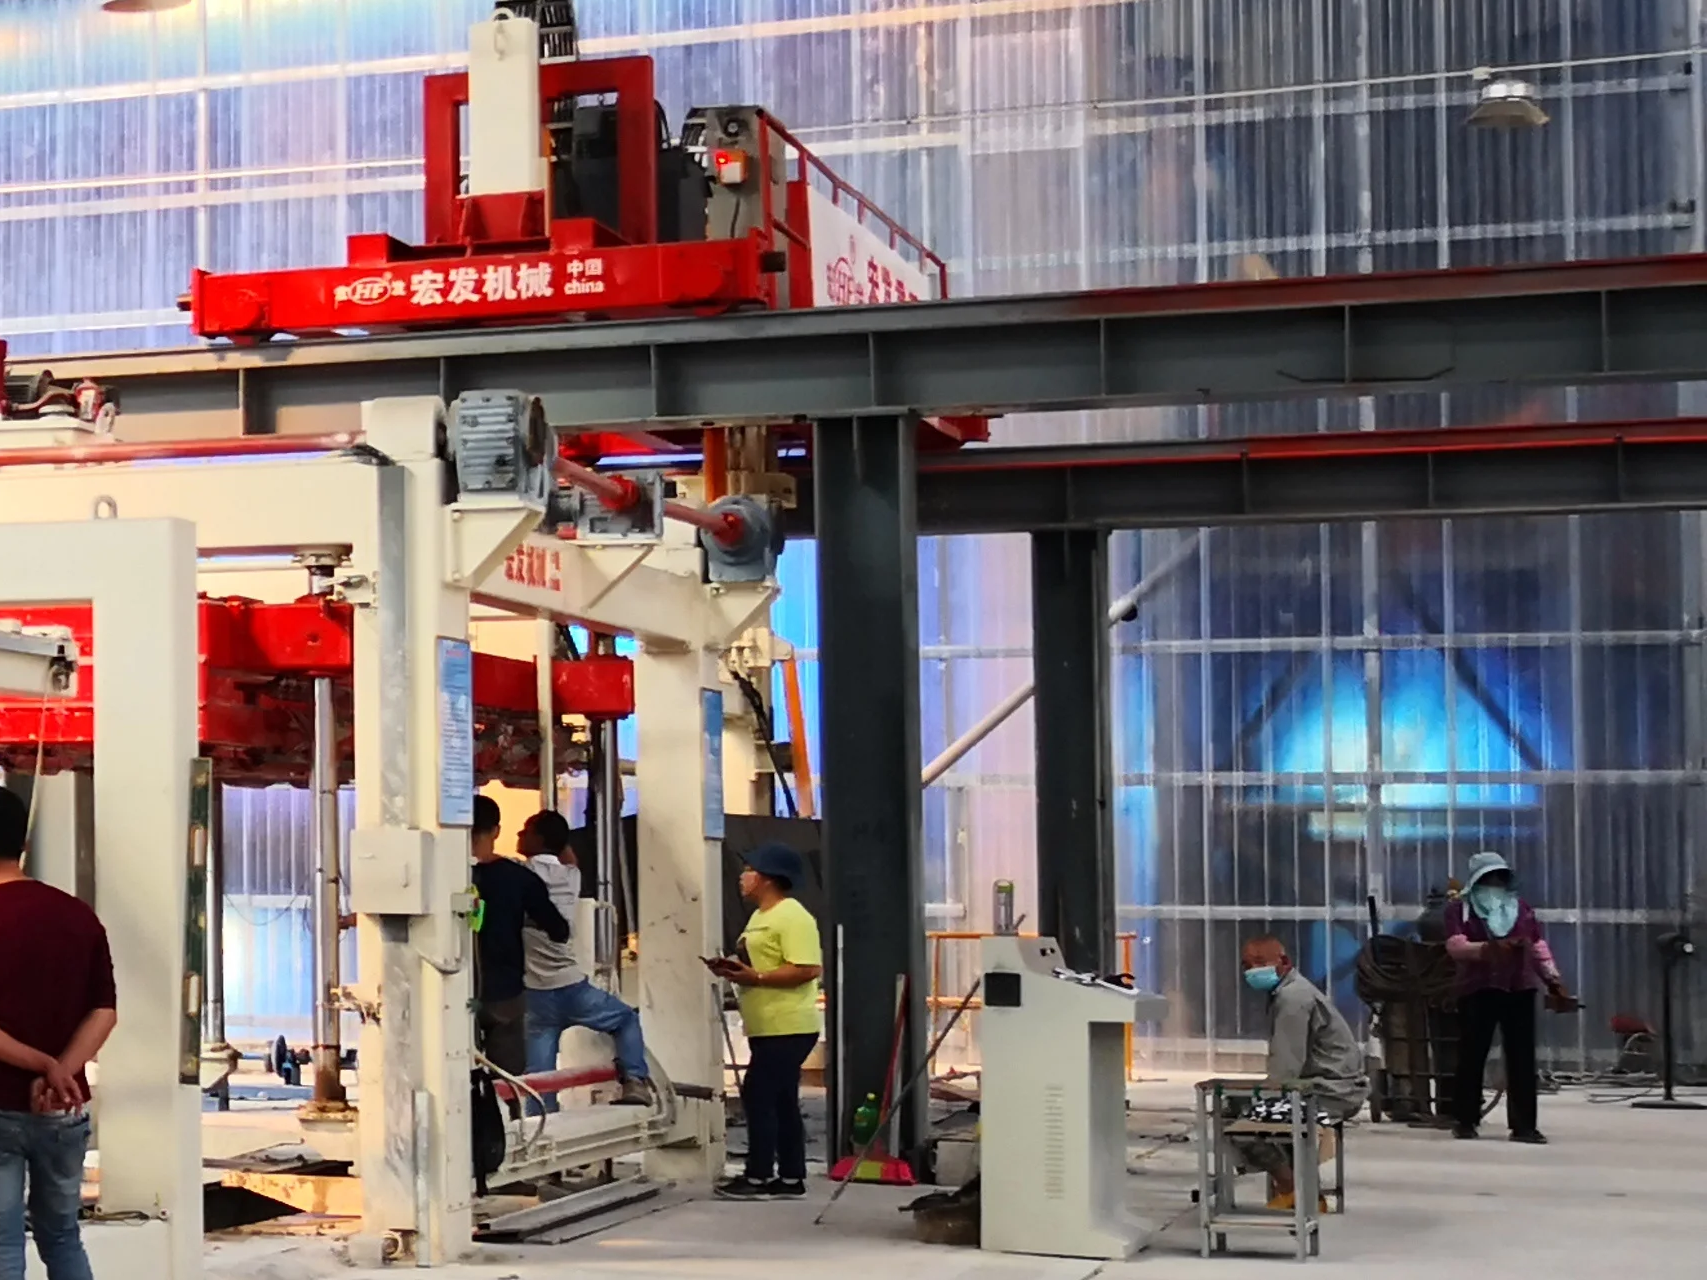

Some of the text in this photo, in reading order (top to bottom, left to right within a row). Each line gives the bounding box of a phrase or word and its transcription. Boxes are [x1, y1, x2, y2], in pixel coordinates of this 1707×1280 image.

[566, 258, 602, 277] 中国
[409, 261, 554, 306] 宏发机械
[564, 278, 605, 296] china
